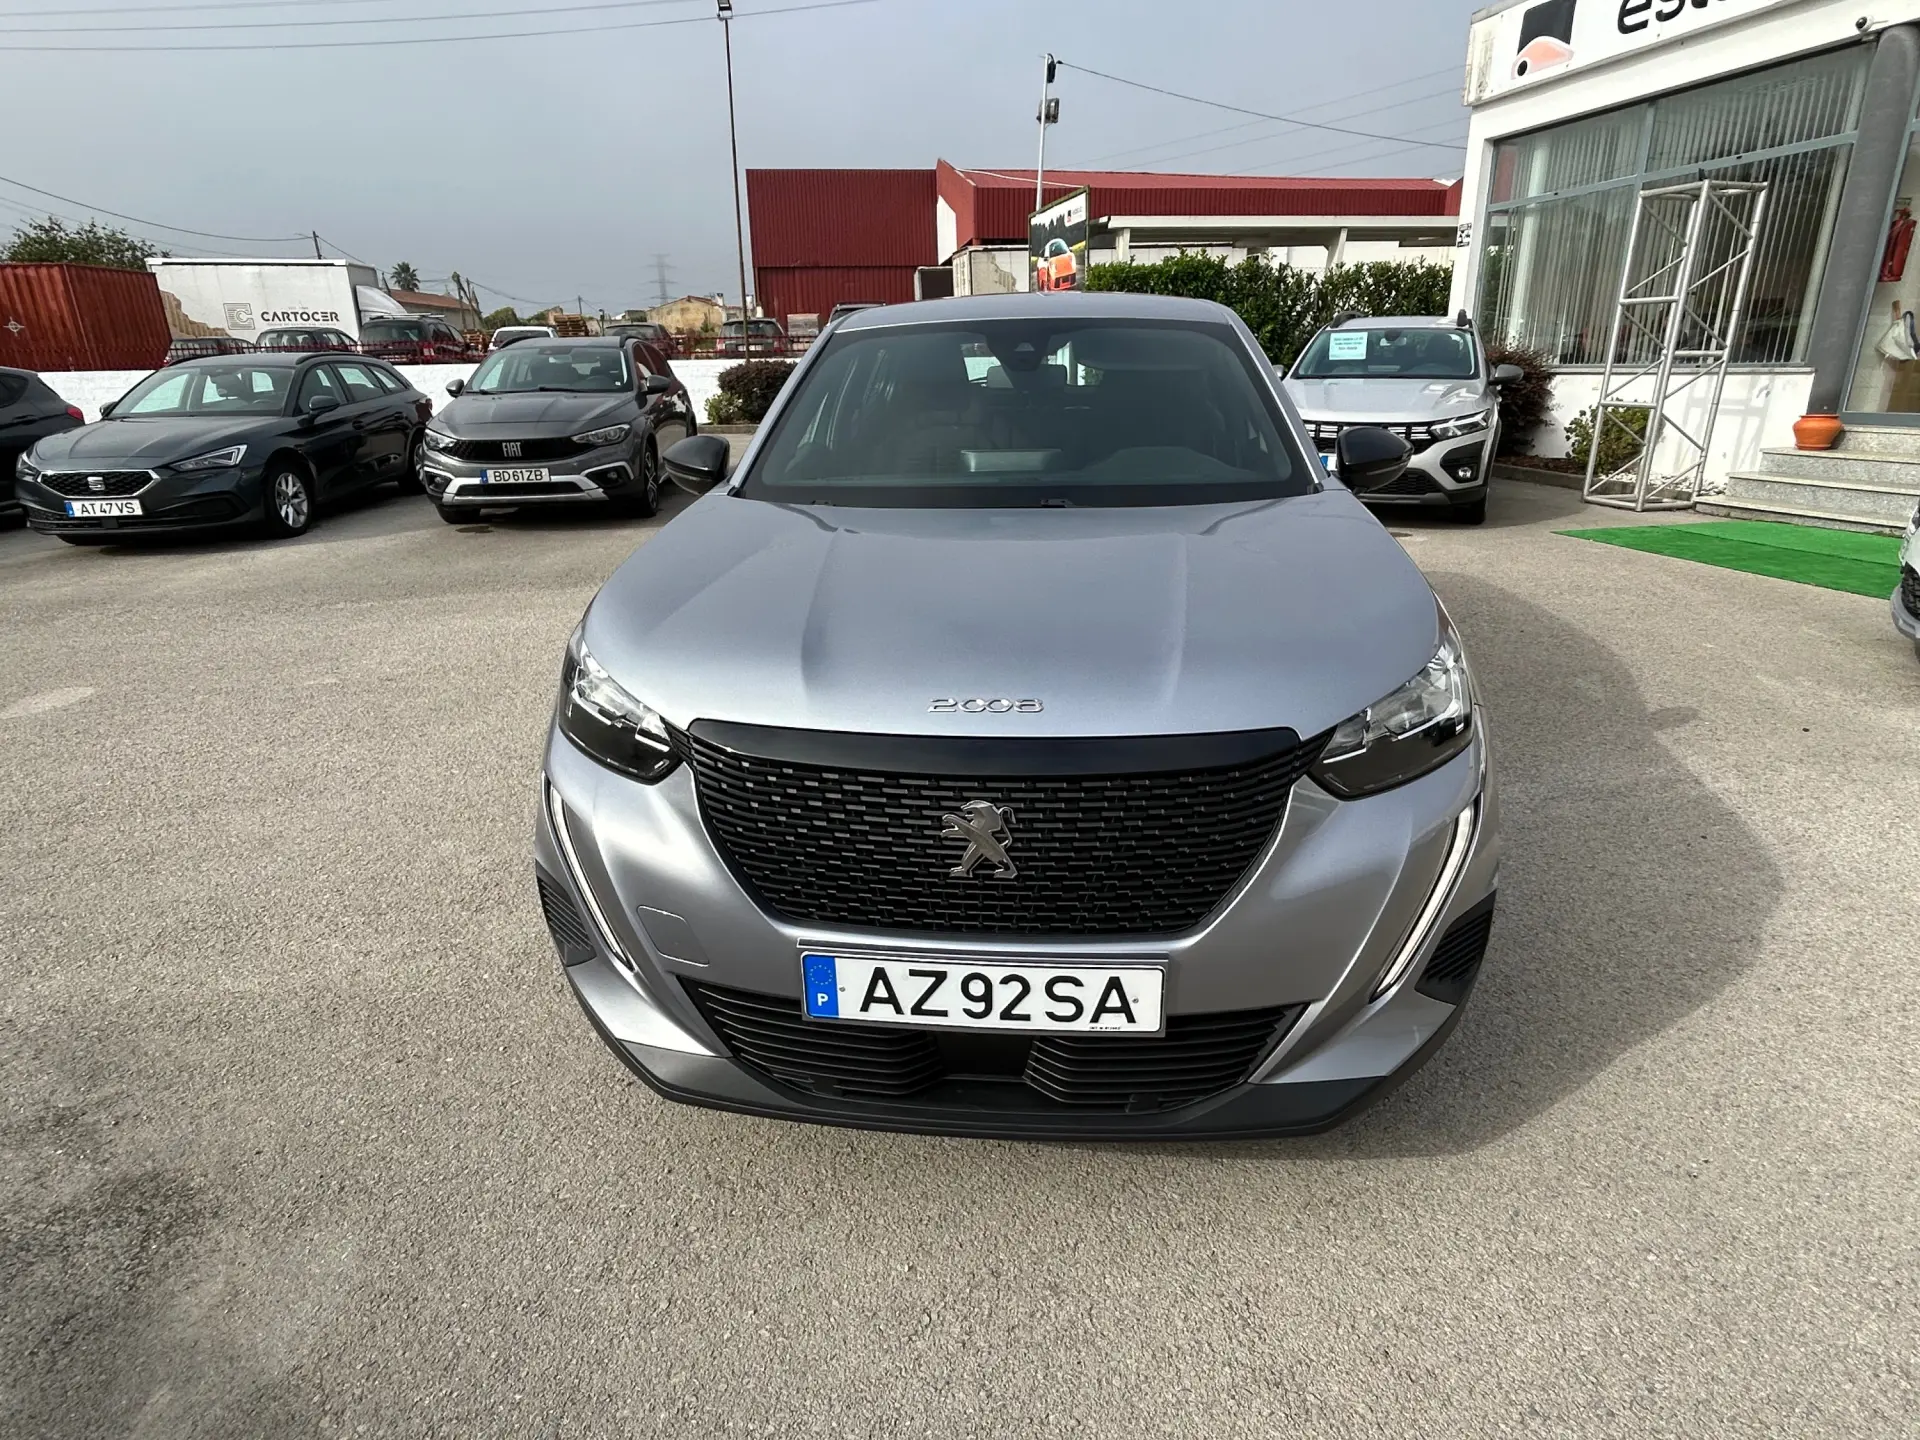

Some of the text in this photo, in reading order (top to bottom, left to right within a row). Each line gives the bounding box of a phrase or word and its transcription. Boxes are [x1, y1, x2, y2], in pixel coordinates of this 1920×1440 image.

[261, 311, 340, 322] CARTOCER
[502, 442, 522, 457] FIAT
[927, 698, 1044, 713] 2008
[817, 992, 829, 1007] P
